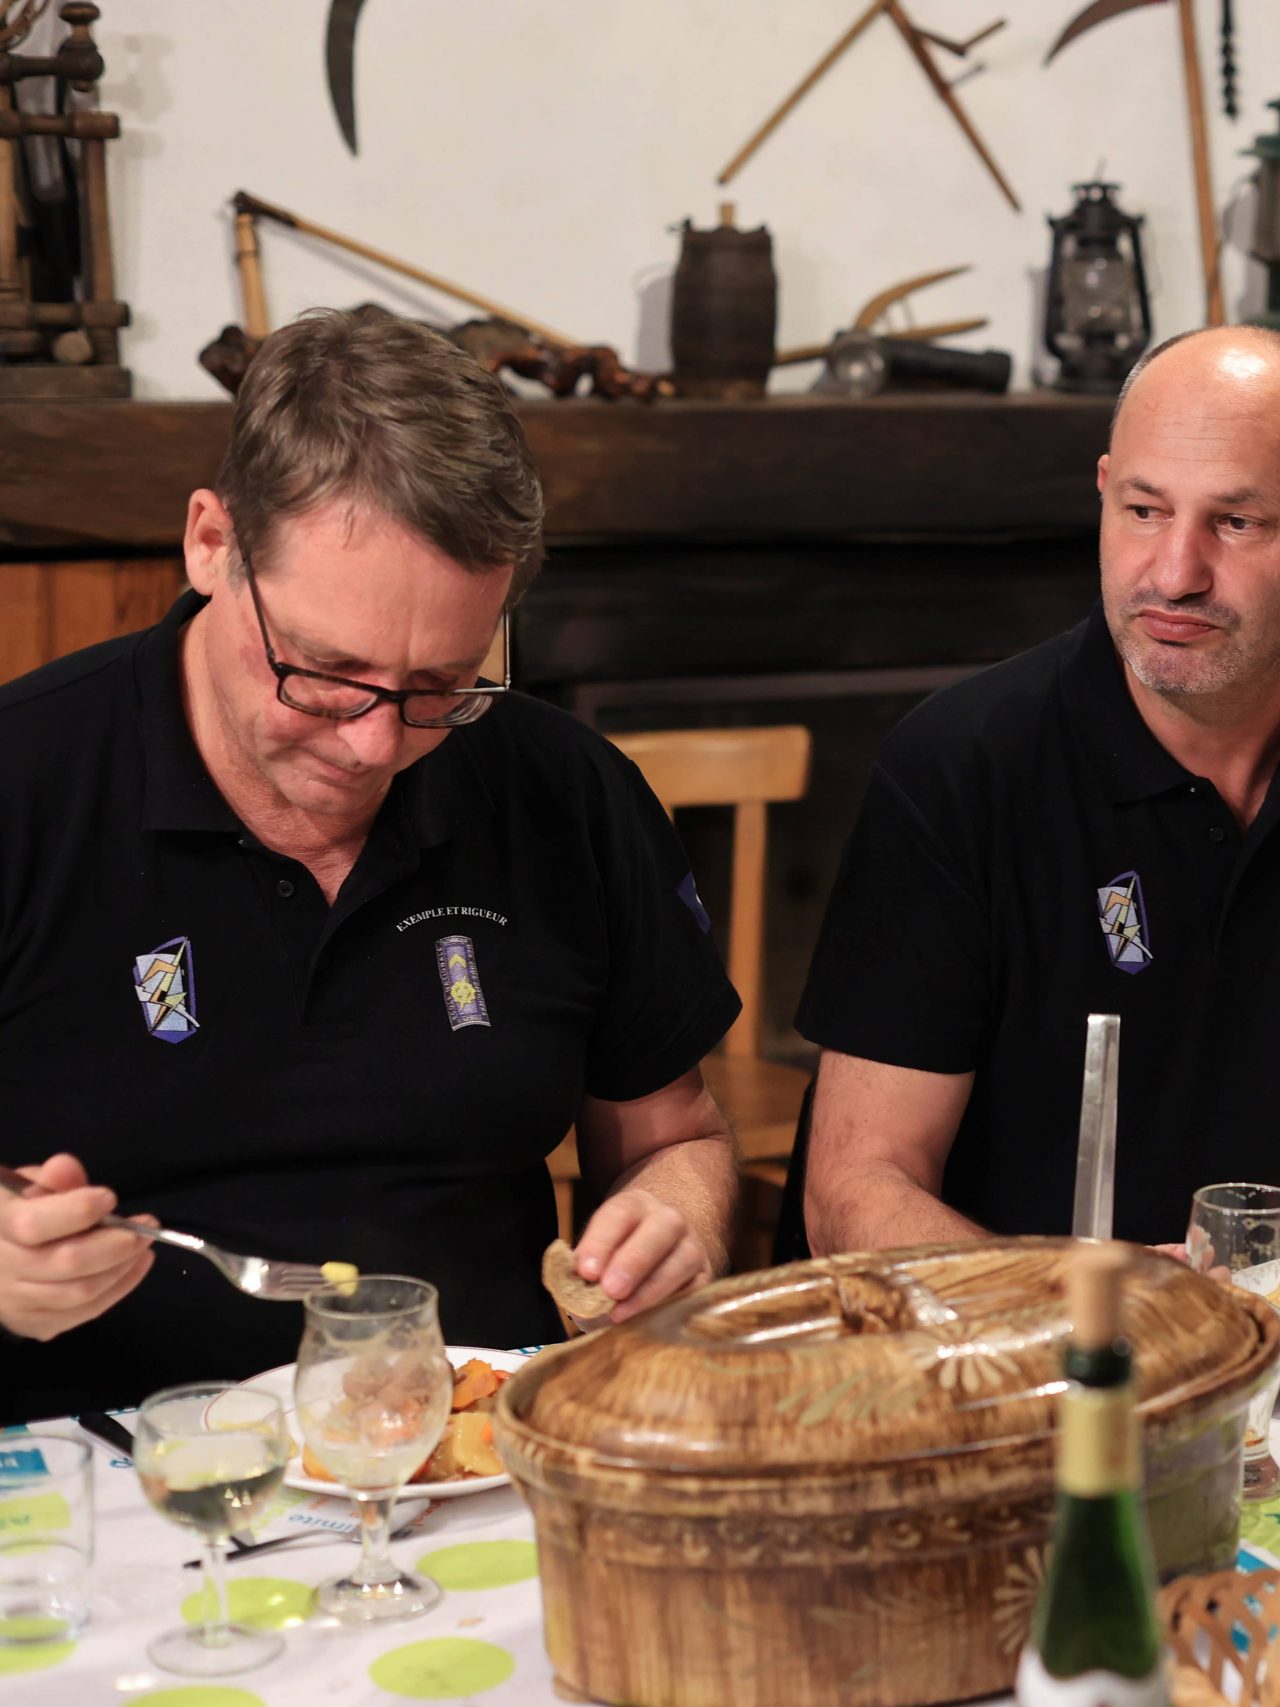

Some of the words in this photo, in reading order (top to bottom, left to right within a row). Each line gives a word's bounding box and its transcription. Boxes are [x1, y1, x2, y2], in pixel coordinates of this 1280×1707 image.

[396, 907, 445, 932] EXEMPLE
[446, 906, 459, 915] ET
[461, 906, 508, 926] RIGUEUR
